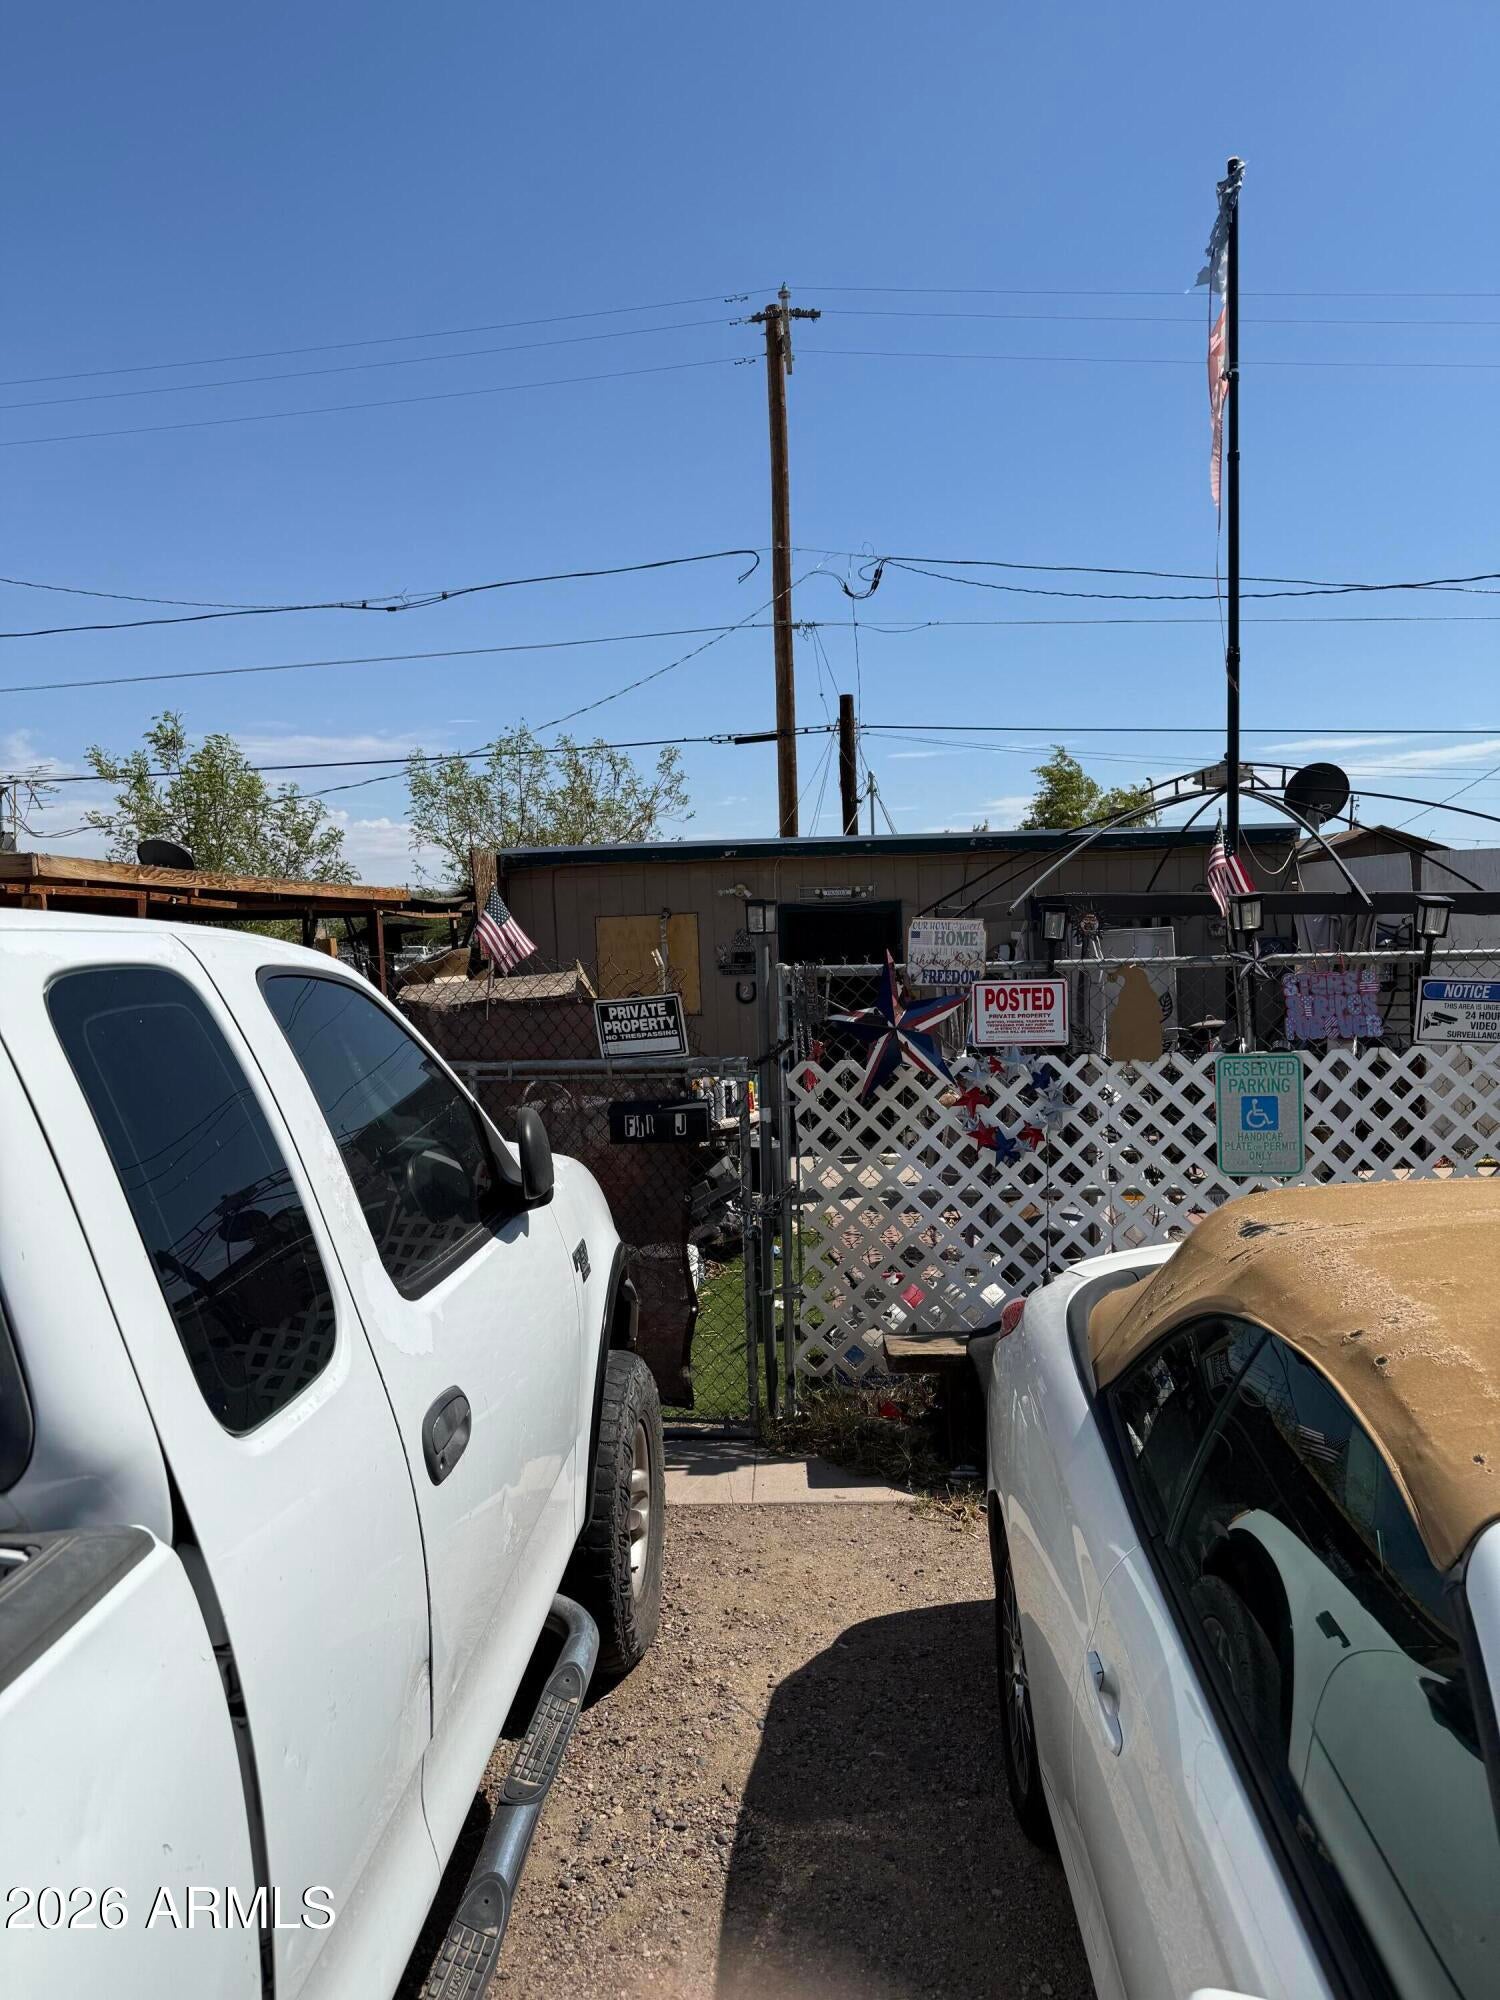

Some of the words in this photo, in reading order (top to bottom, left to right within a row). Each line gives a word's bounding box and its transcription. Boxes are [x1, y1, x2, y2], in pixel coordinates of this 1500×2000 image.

[934, 930, 978, 946] HOME
[921, 969, 981, 984] FREEDOM
[984, 987, 1055, 1011] POSTED
[1444, 984, 1491, 999] NOTICE
[608, 1002, 667, 1020] PRIVATE
[1465, 1011, 1476, 1020] 24
[603, 1015, 675, 1034] PROPERTY
[1470, 1021, 1497, 1031] VIDEO
[620, 1029, 678, 1039] TRESPASSING
[1223, 1061, 1295, 1076] RESERVED
[1228, 1078, 1290, 1093] PARKING
[1237, 1132, 1284, 1141] HANDICAP
[1225, 1142, 1253, 1151] PLATE
[1263, 1142, 1297, 1151] PERMIT
[1249, 1151, 1272, 1160] ONLY
